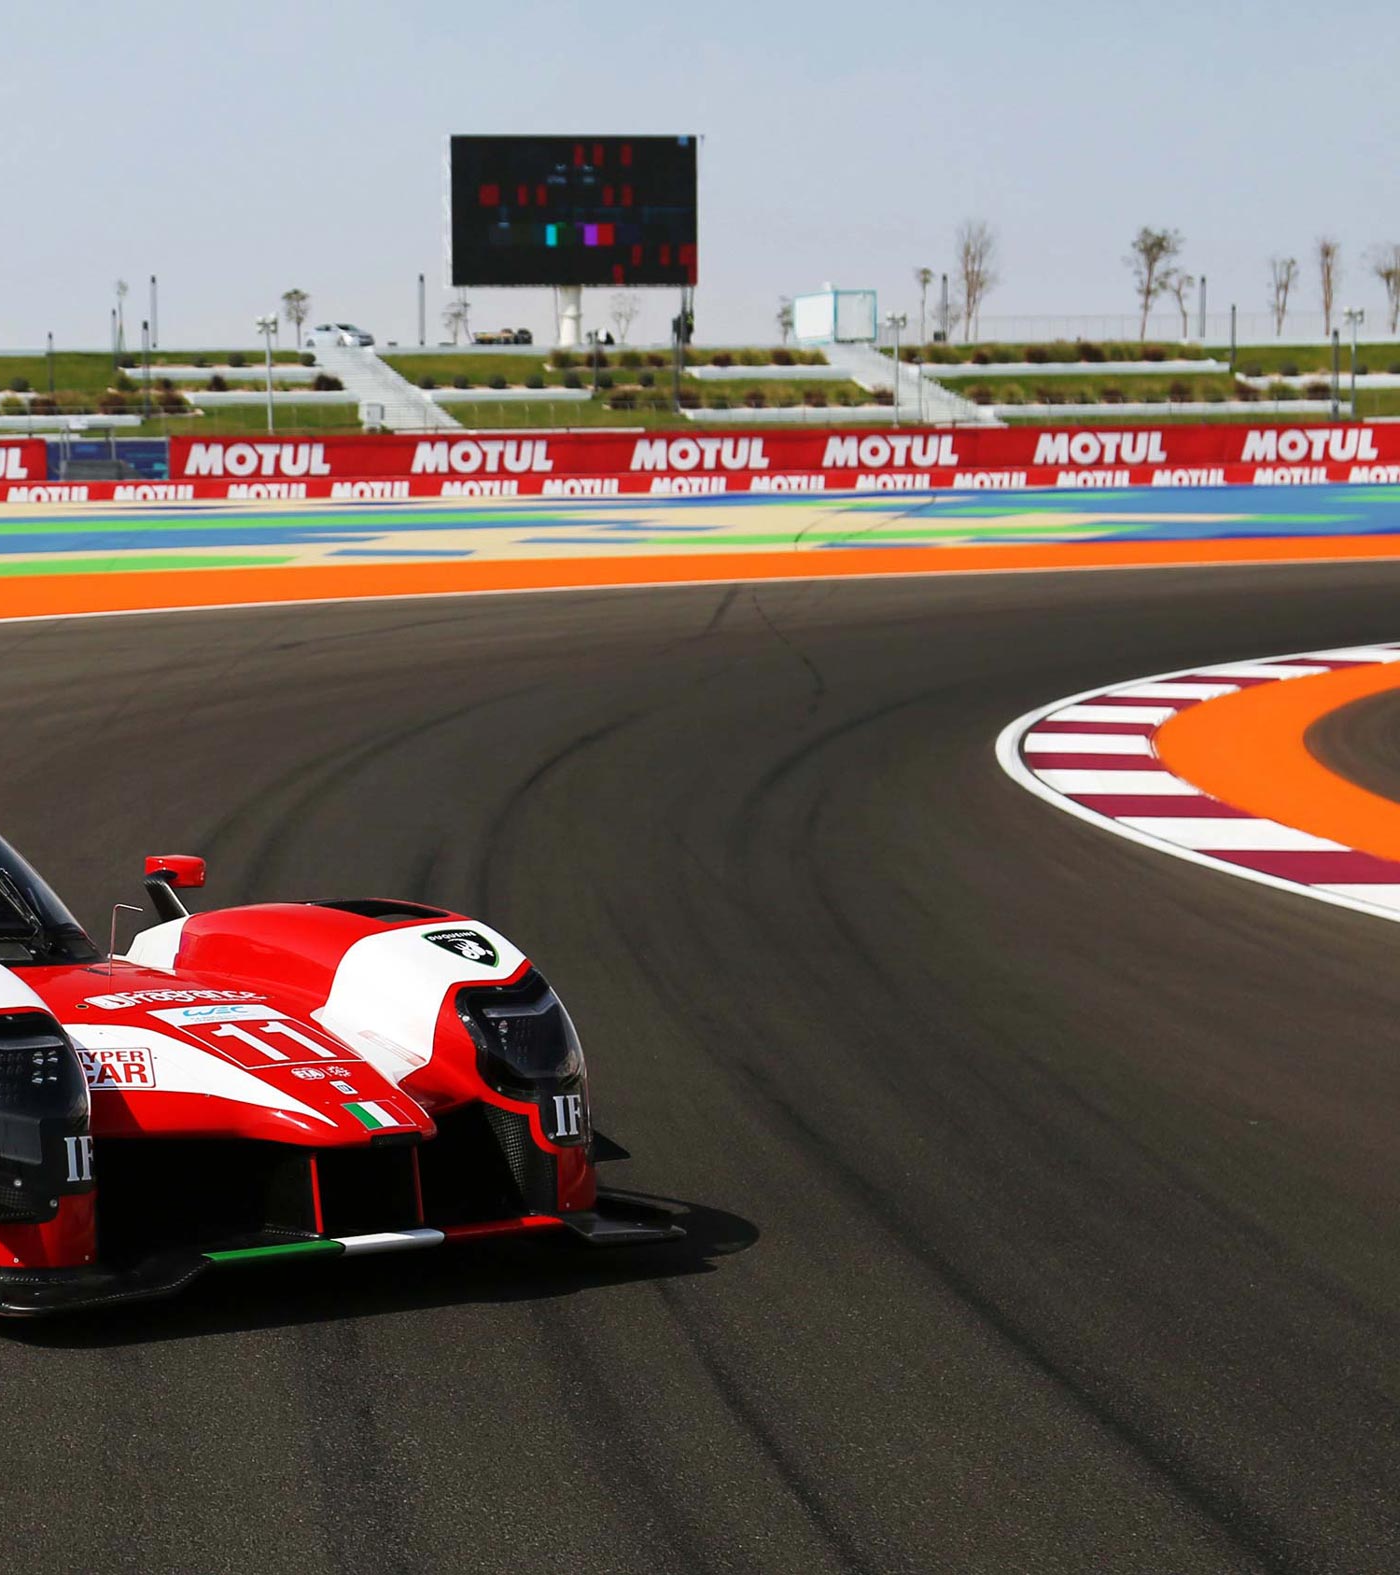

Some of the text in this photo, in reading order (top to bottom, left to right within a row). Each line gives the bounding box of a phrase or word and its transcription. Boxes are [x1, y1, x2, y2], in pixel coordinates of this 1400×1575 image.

[185, 443, 331, 476] MOTUL
[412, 440, 553, 473] MOTUL
[631, 438, 770, 470] MOTUL
[823, 435, 959, 467] MOTUL
[1033, 432, 1167, 464] MOTUL
[1241, 429, 1378, 462] MOTUL
[1348, 465, 1400, 484] MOT
[211, 1020, 338, 1061] 11
